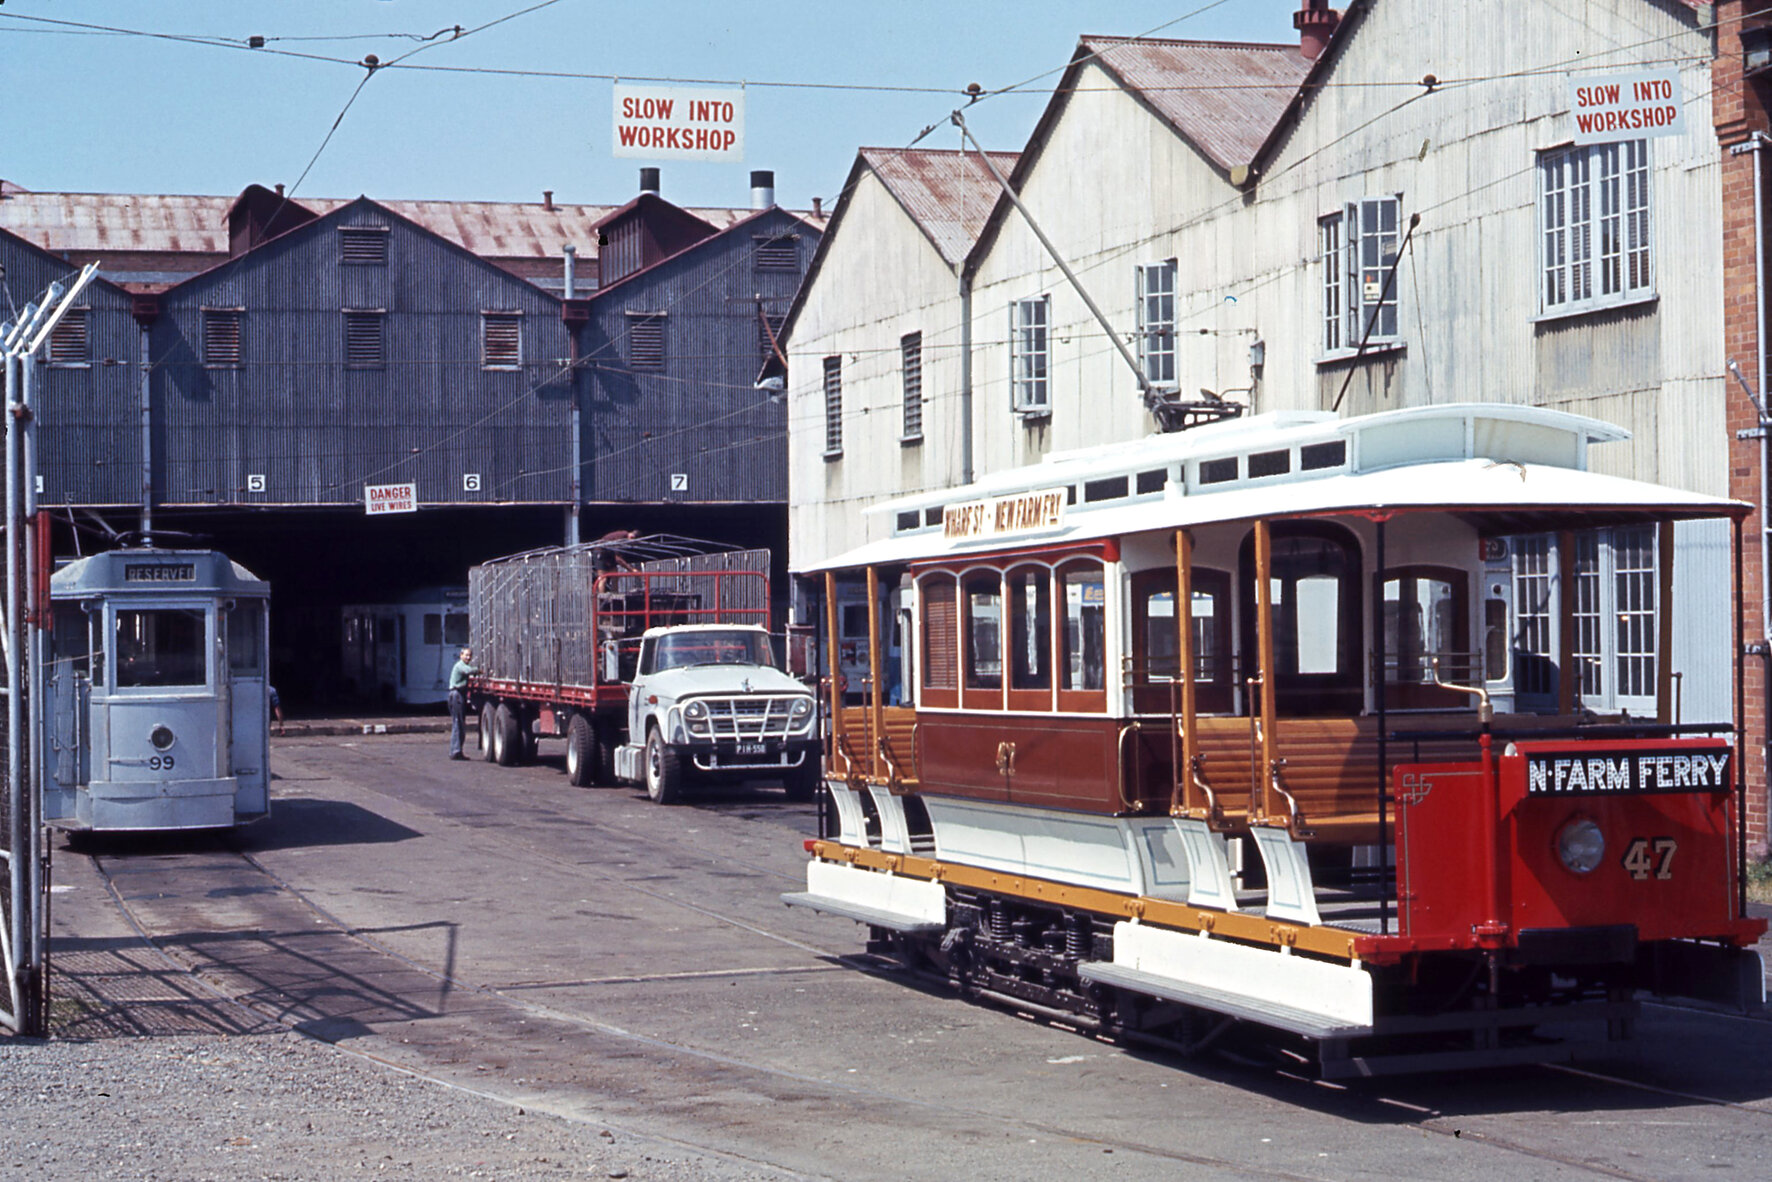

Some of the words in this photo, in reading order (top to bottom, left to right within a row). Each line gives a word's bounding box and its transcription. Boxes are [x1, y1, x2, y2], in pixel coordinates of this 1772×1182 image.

[1577, 83, 1620, 107] SLOW
[1633, 79, 1672, 102] INTO
[623, 97, 674, 120] SLOW
[689, 100, 734, 123] INTO
[1576, 105, 1677, 134] WORKSHOP
[618, 125, 736, 151] WORKSHOP
[251, 476, 263, 490] 5
[466, 475, 478, 489] 6
[673, 475, 685, 489] 7
[370, 487, 411, 500] DANGER
[371, 503, 386, 512] LIVE
[388, 501, 412, 511] WIRES
[944, 507, 972, 538] WHARF
[994, 500, 1016, 532] NEW
[1016, 495, 1043, 530] FARM
[128, 567, 194, 581] RESERVED
[150, 755, 175, 771] 99
[1638, 754, 1729, 789] FERRY
[1622, 837, 1678, 880] 47
